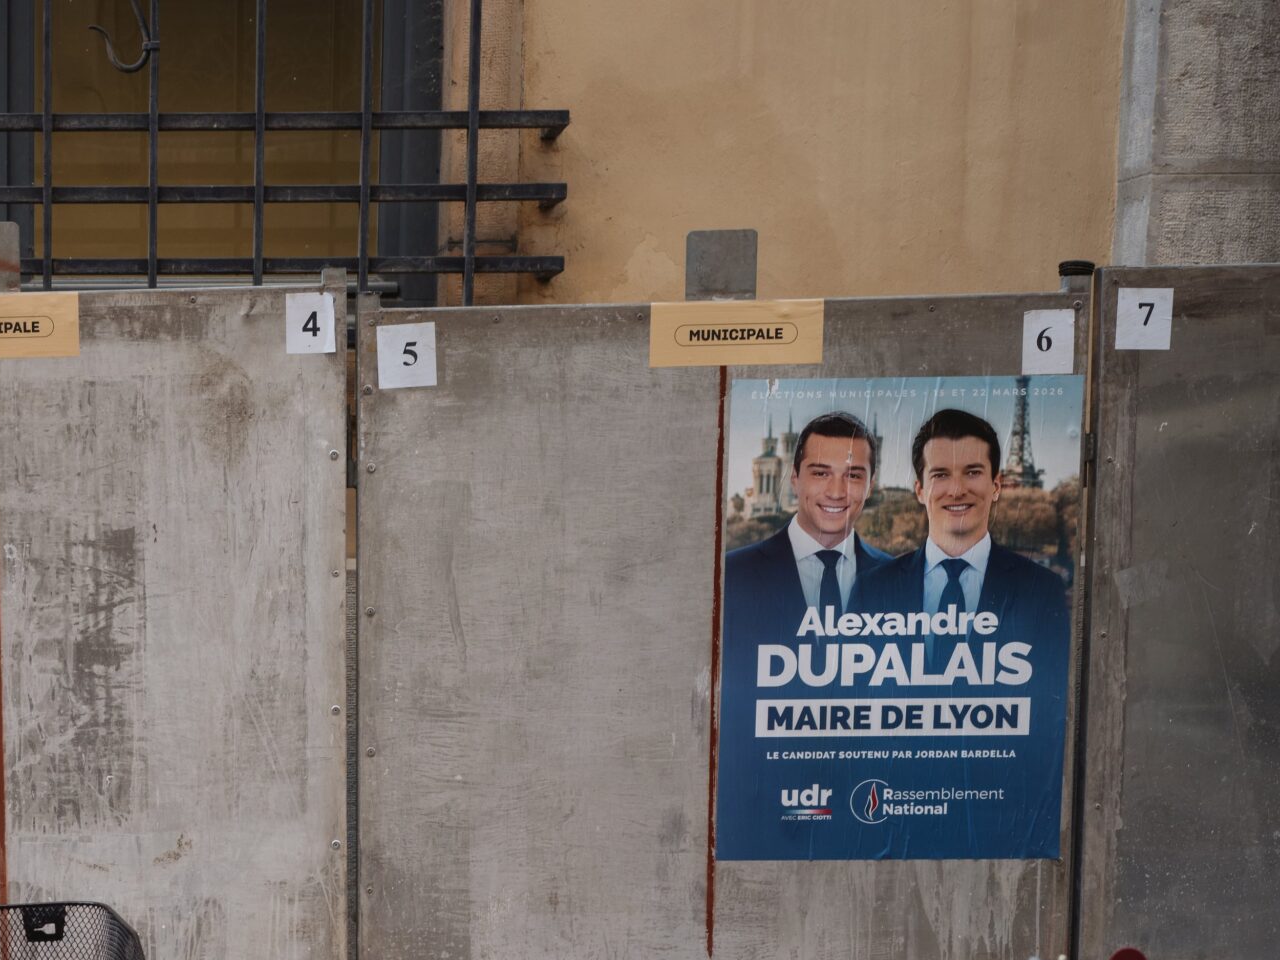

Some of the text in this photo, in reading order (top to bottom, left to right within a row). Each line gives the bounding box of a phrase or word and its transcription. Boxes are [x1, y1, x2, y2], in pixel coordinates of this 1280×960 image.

[302, 311, 320, 336] 4
[1139, 303, 1154, 326] 7
[690, 328, 783, 341] MUNICIPALE
[1037, 328, 1052, 351] 6
[403, 342, 417, 366] 5
[829, 390, 917, 398] MUNICIPALES
[993, 388, 1027, 396] MARS
[797, 603, 998, 636] Alexandre
[757, 642, 1032, 687] DUPALAIS
[767, 704, 1018, 730] MAIRE DE LYON
[782, 751, 836, 759] CANDIDAT
[782, 784, 832, 806] udr
[883, 788, 1004, 800] Rassemblement
[883, 803, 947, 814] National
